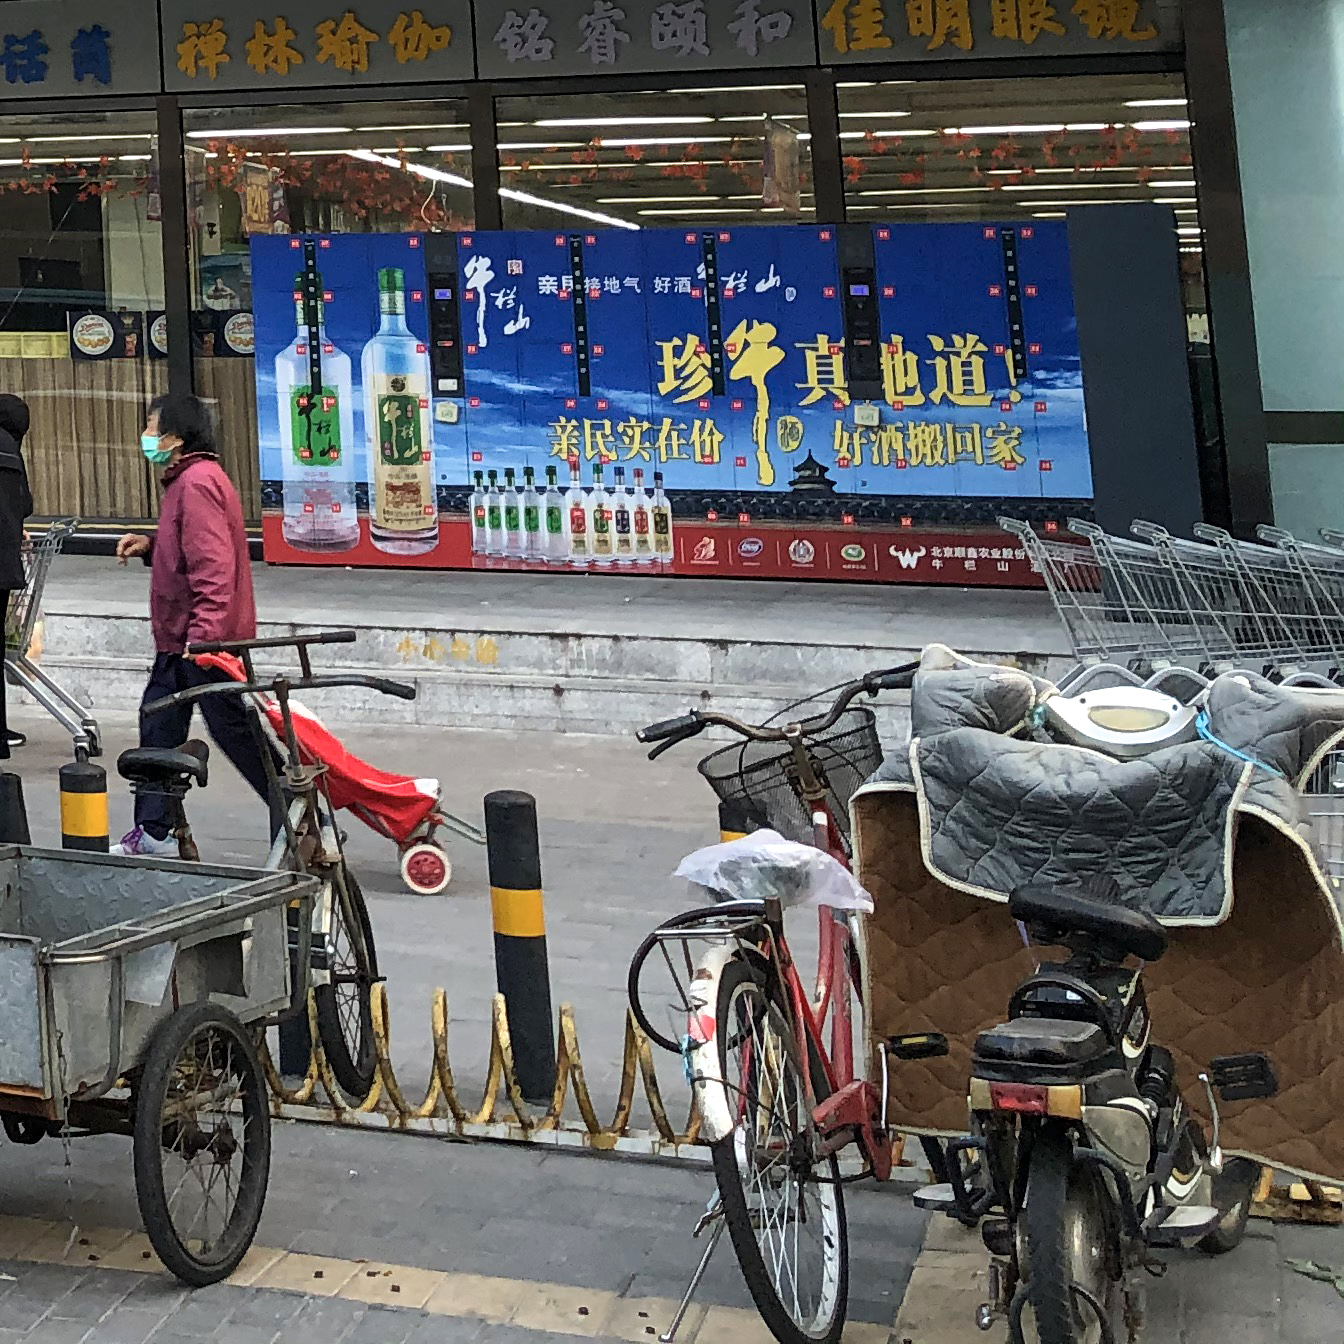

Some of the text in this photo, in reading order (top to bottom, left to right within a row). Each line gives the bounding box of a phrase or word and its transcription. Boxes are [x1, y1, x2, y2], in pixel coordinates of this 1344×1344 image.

[176, 10, 451, 81] 禅林瑜伽
[653, 276, 692, 295] 好酒
[547, 416, 1025, 468] 亲民实在价 好酒搬回家
